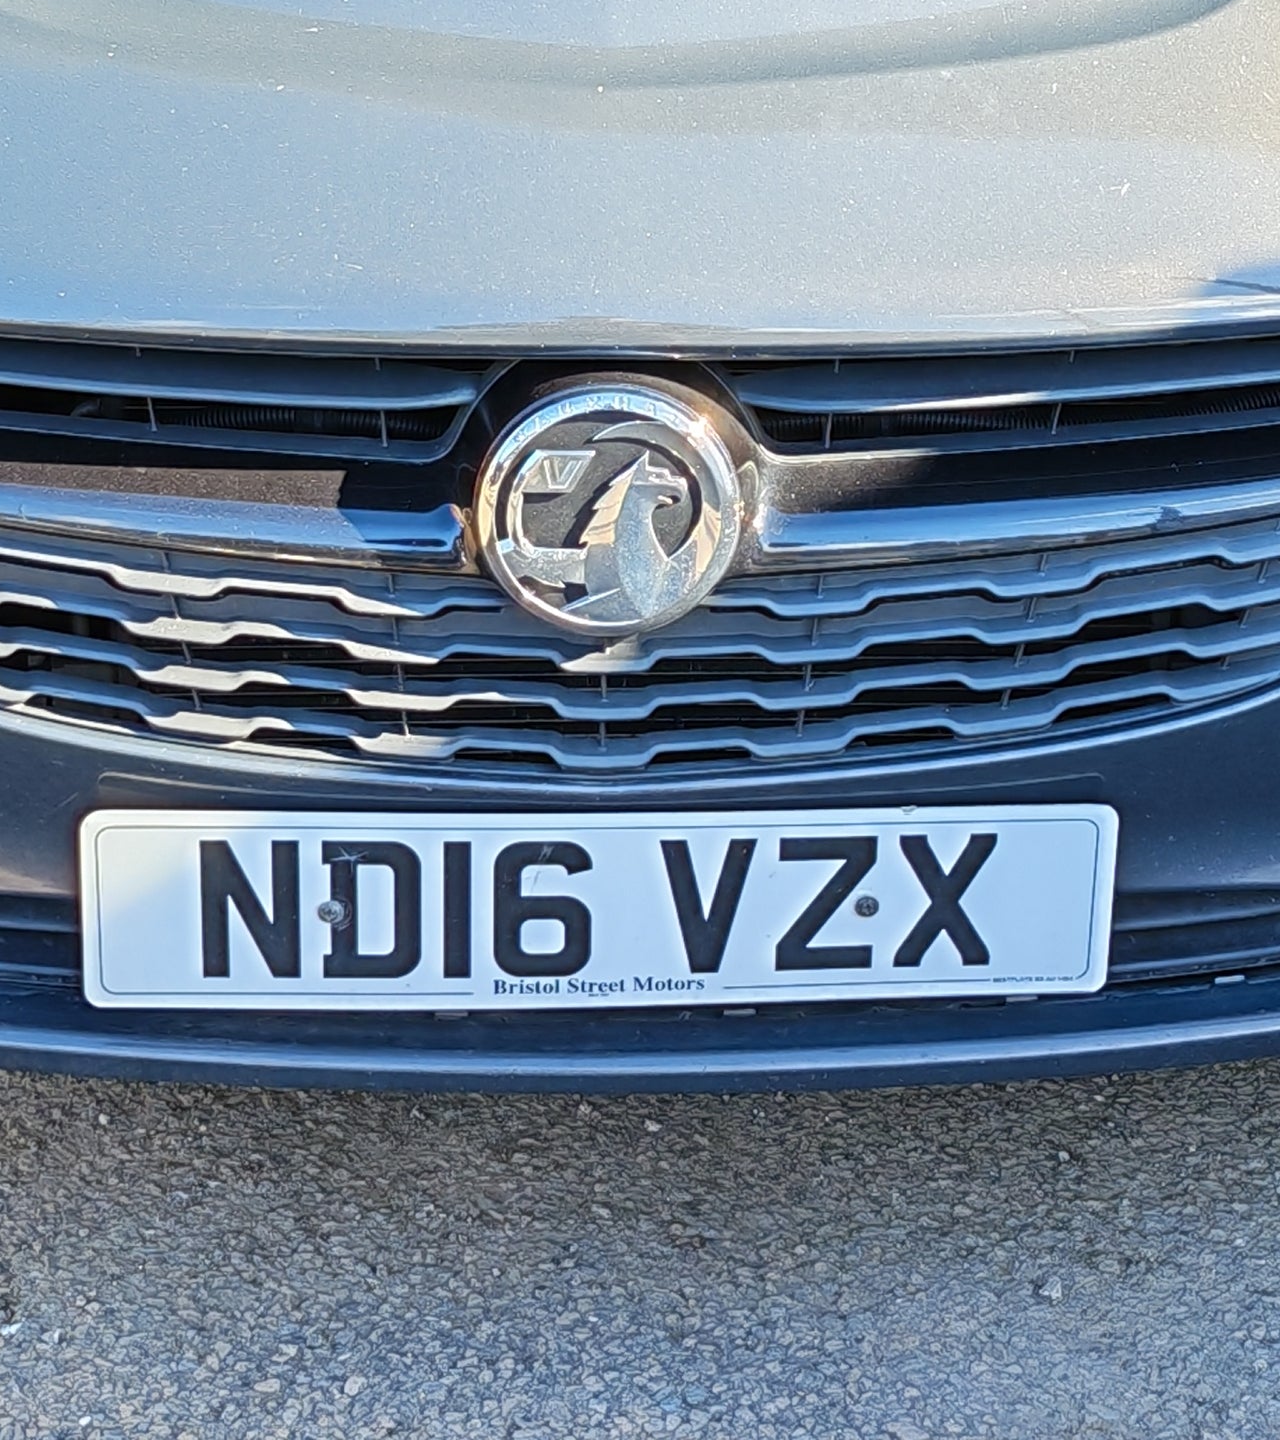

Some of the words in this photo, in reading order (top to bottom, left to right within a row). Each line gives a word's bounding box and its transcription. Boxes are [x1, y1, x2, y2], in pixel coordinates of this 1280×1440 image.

[199, 840, 594, 979] ND16
[660, 833, 998, 973] VZX
[493, 979, 560, 995] Bristol
[567, 977, 626, 994] Street
[632, 975, 706, 992] Motors
